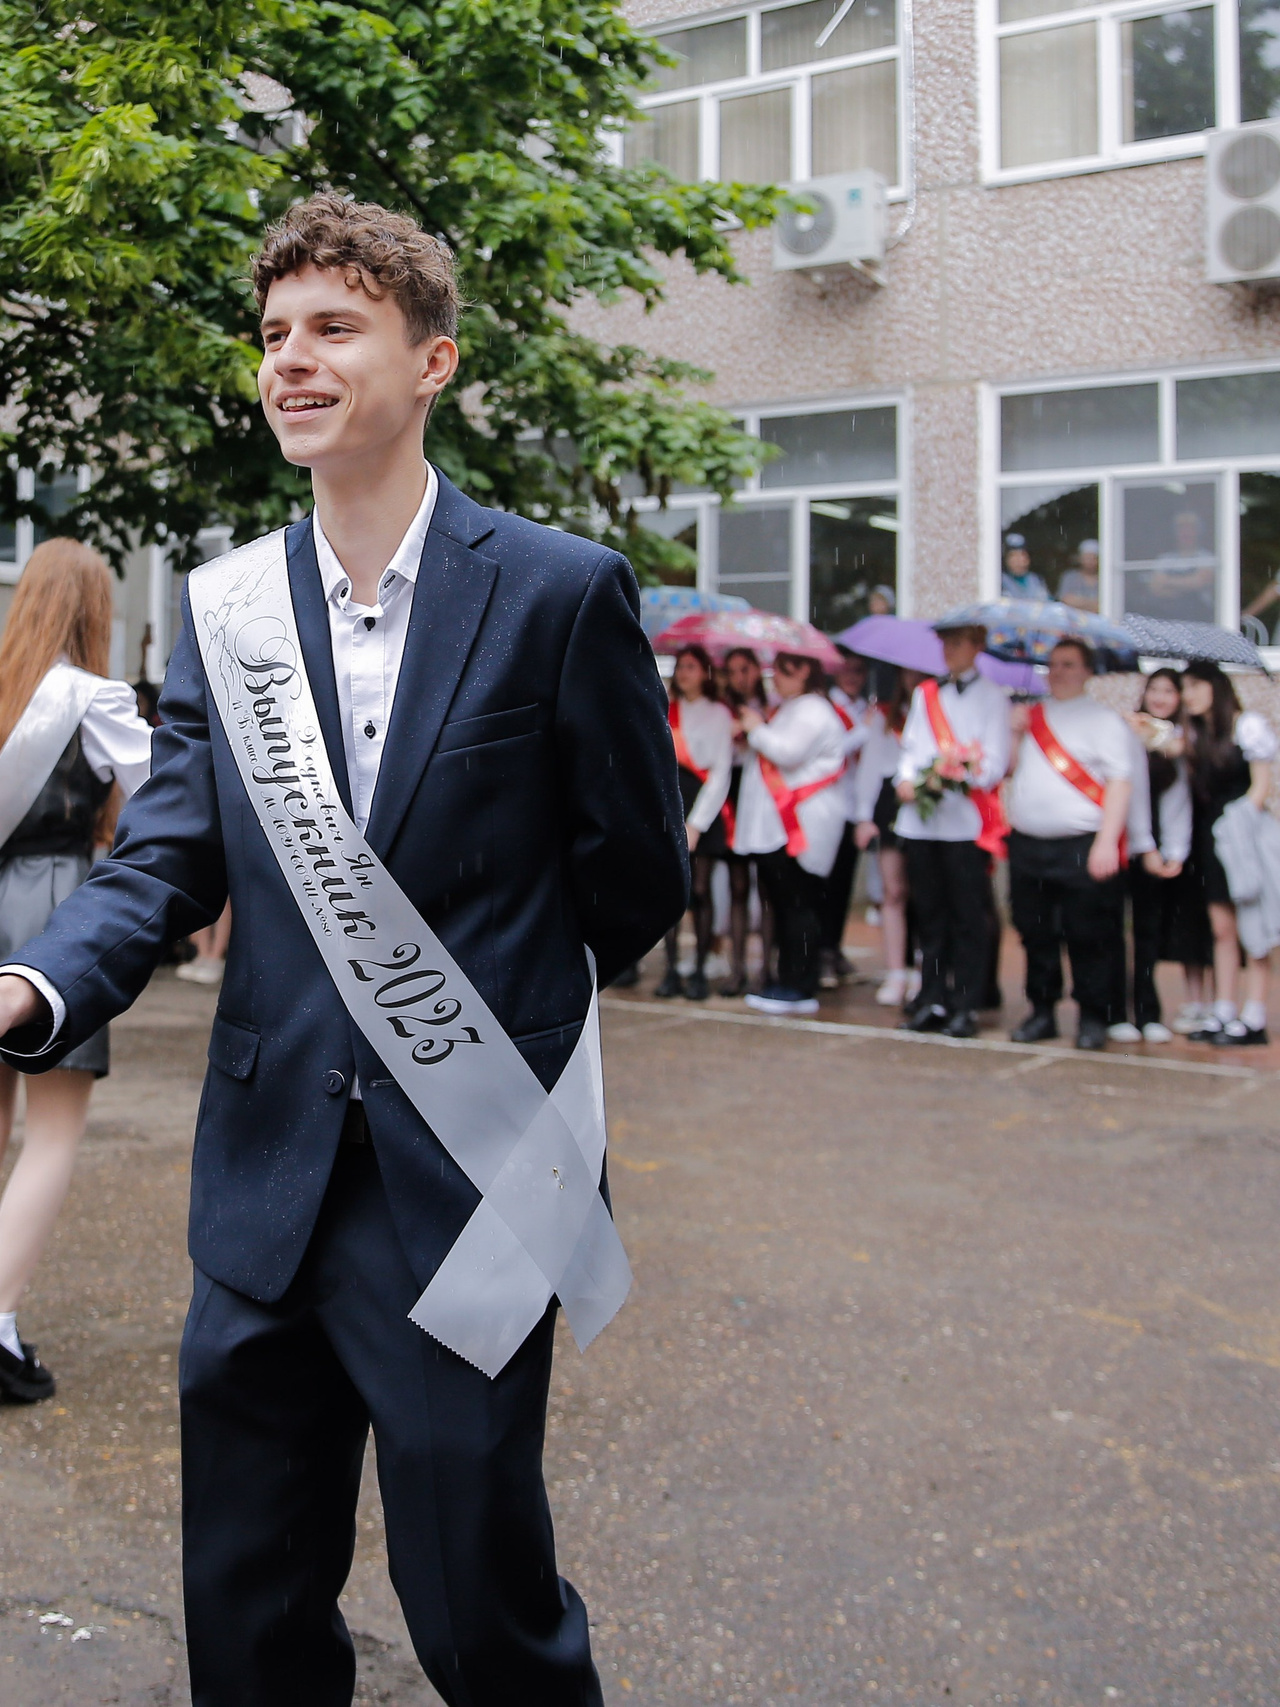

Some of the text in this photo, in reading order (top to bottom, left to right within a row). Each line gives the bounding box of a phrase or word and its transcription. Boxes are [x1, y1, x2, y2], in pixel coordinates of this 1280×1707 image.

[242, 735, 258, 764] класс
[234, 615, 486, 1066] Выпускник 2023
[260, 791, 333, 937] МАОУ СОШ №80
[341, 850, 376, 890] Ян
